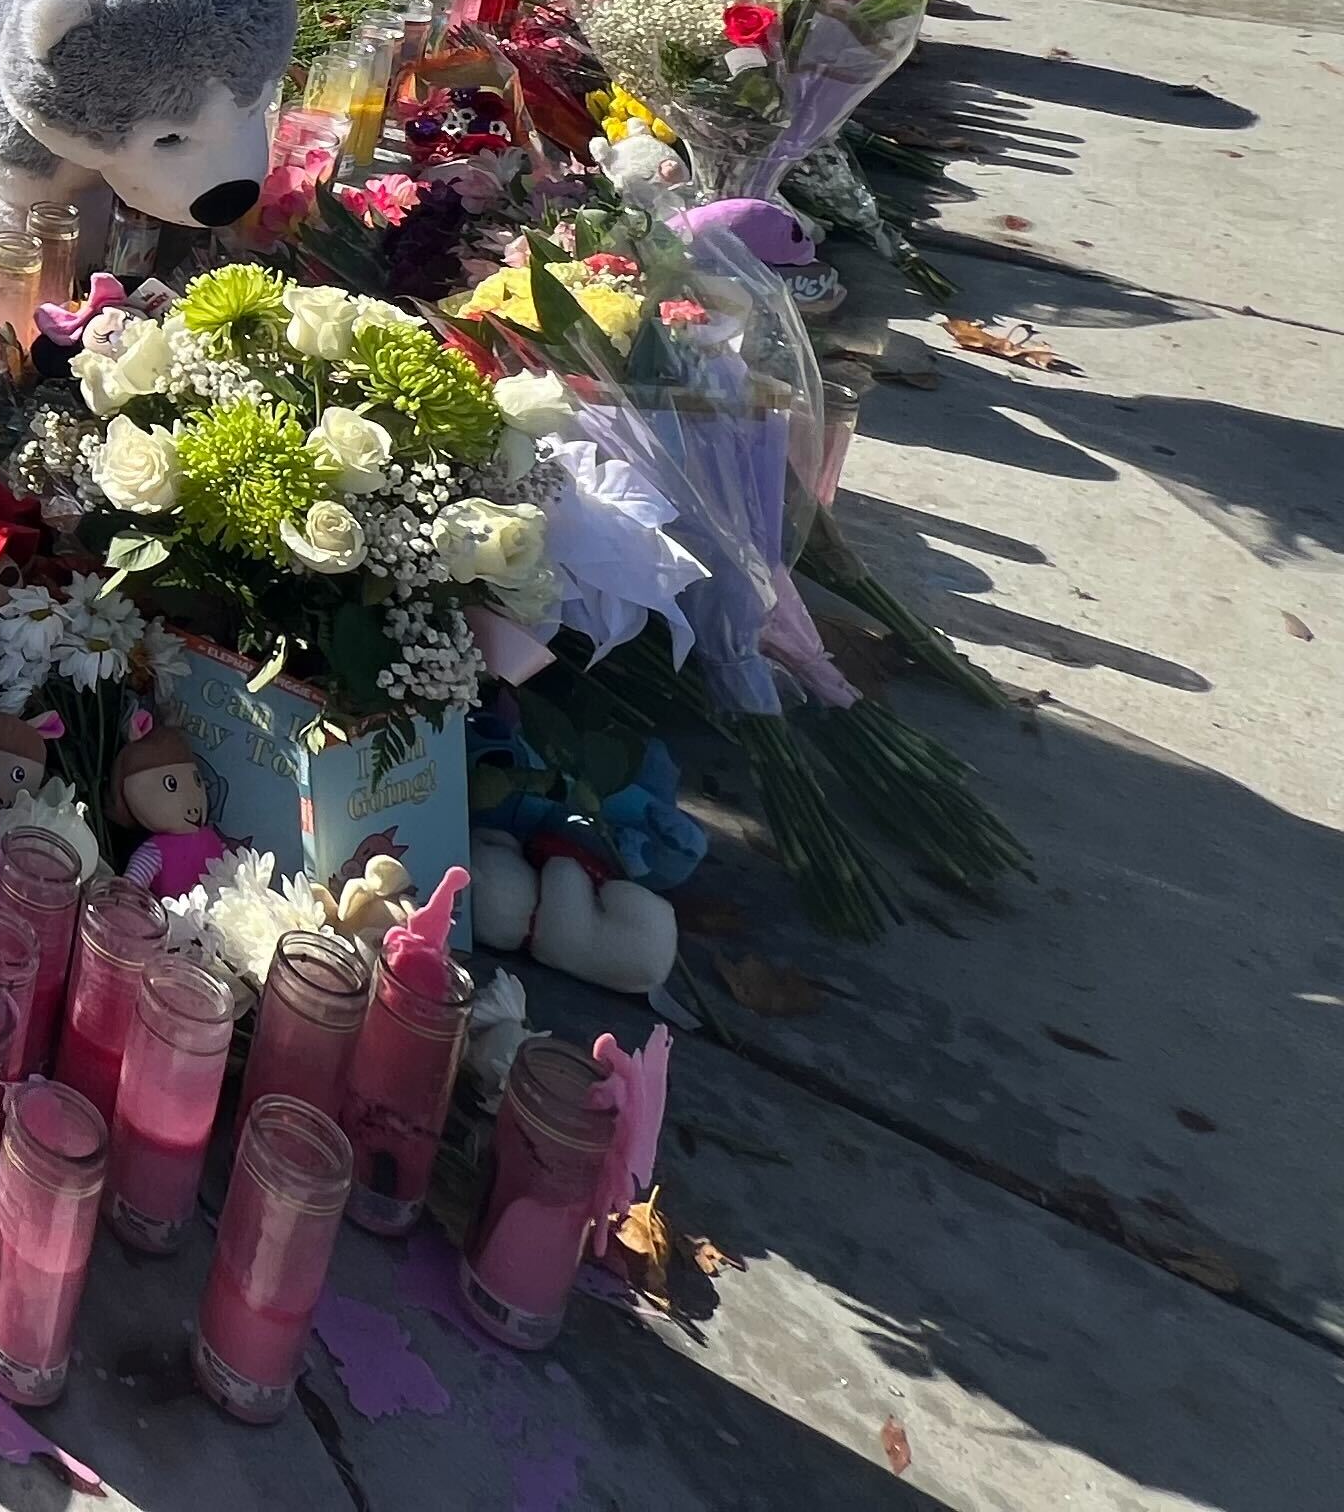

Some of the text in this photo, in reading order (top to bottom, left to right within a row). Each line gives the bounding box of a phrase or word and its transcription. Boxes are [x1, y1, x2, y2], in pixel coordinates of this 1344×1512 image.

[169, 695, 234, 751] lay
[201, 678, 272, 733] Can
[346, 759, 438, 821] Going!
[355, 747, 371, 780] I
